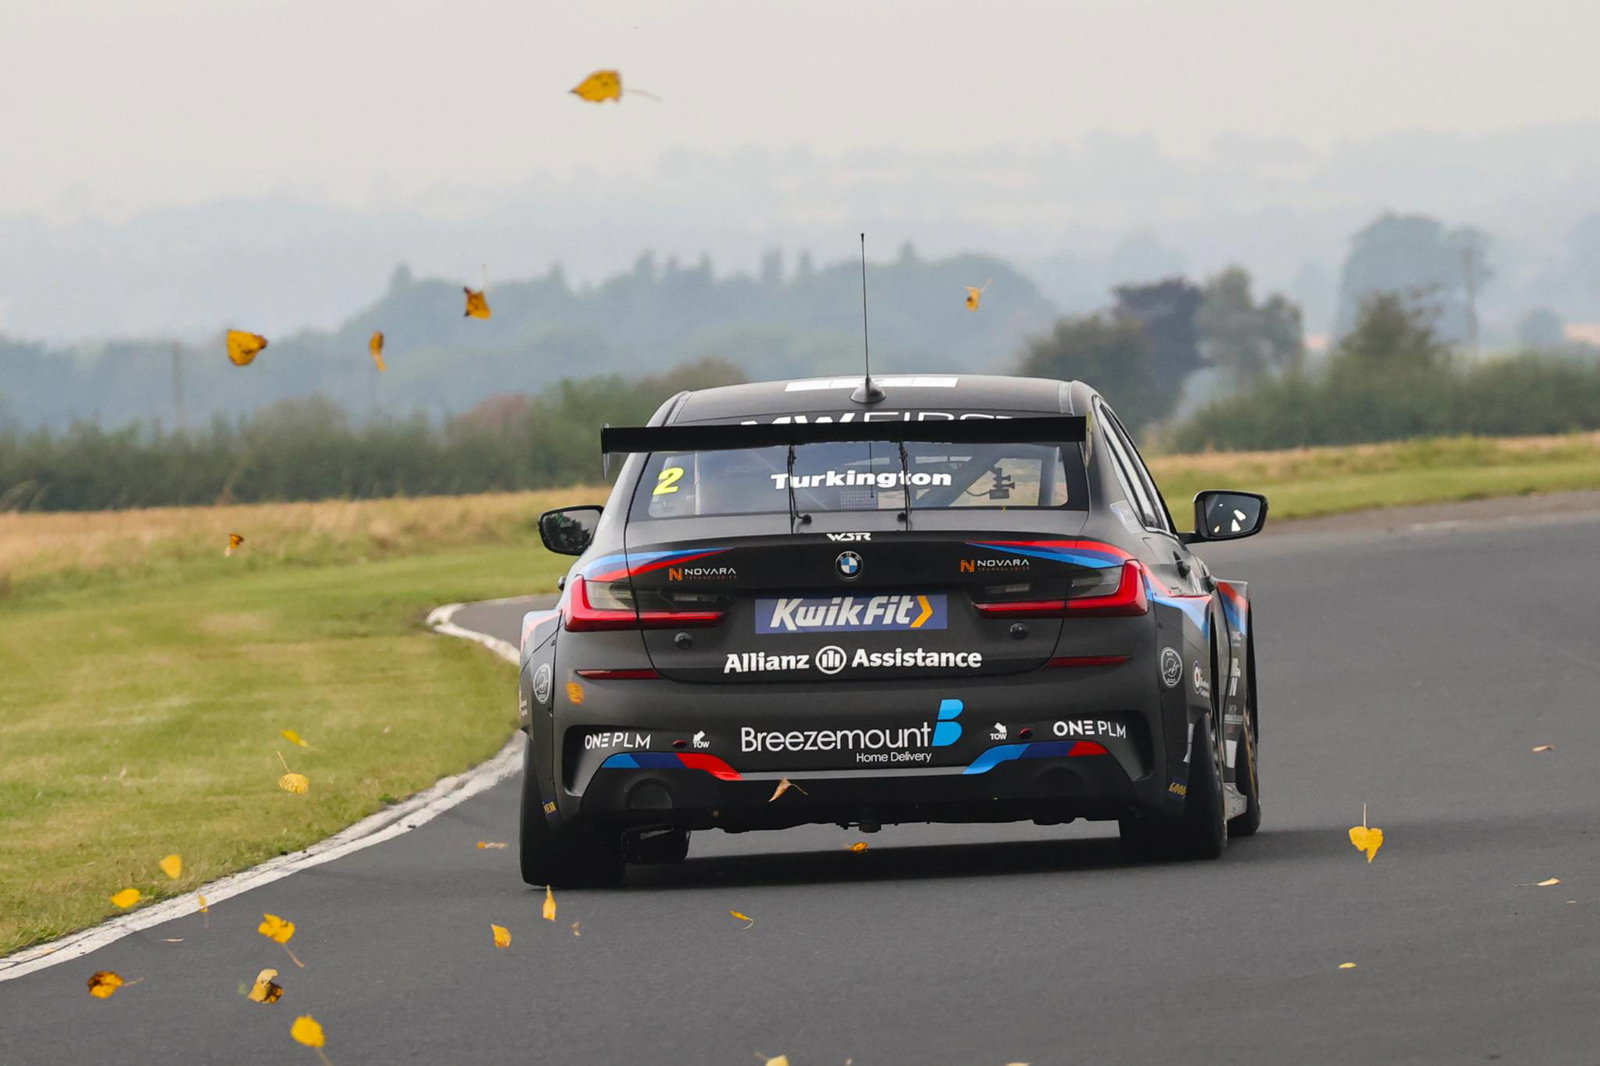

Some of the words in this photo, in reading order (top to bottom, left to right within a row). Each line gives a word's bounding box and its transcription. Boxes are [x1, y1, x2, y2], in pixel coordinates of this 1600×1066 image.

[652, 467, 684, 496] 2
[770, 469, 952, 490] Turkington
[826, 532, 872, 542] WSR
[977, 559, 1030, 567] NOVARA
[684, 567, 737, 575] NOVARA
[723, 652, 810, 674] Allianz
[852, 648, 982, 668] Assistance
[740, 721, 932, 752] Breezemount
[990, 733, 1007, 741] TOW
[693, 741, 710, 749] TOW
[856, 752, 889, 763] Home
[890, 751, 932, 763] Delivery
